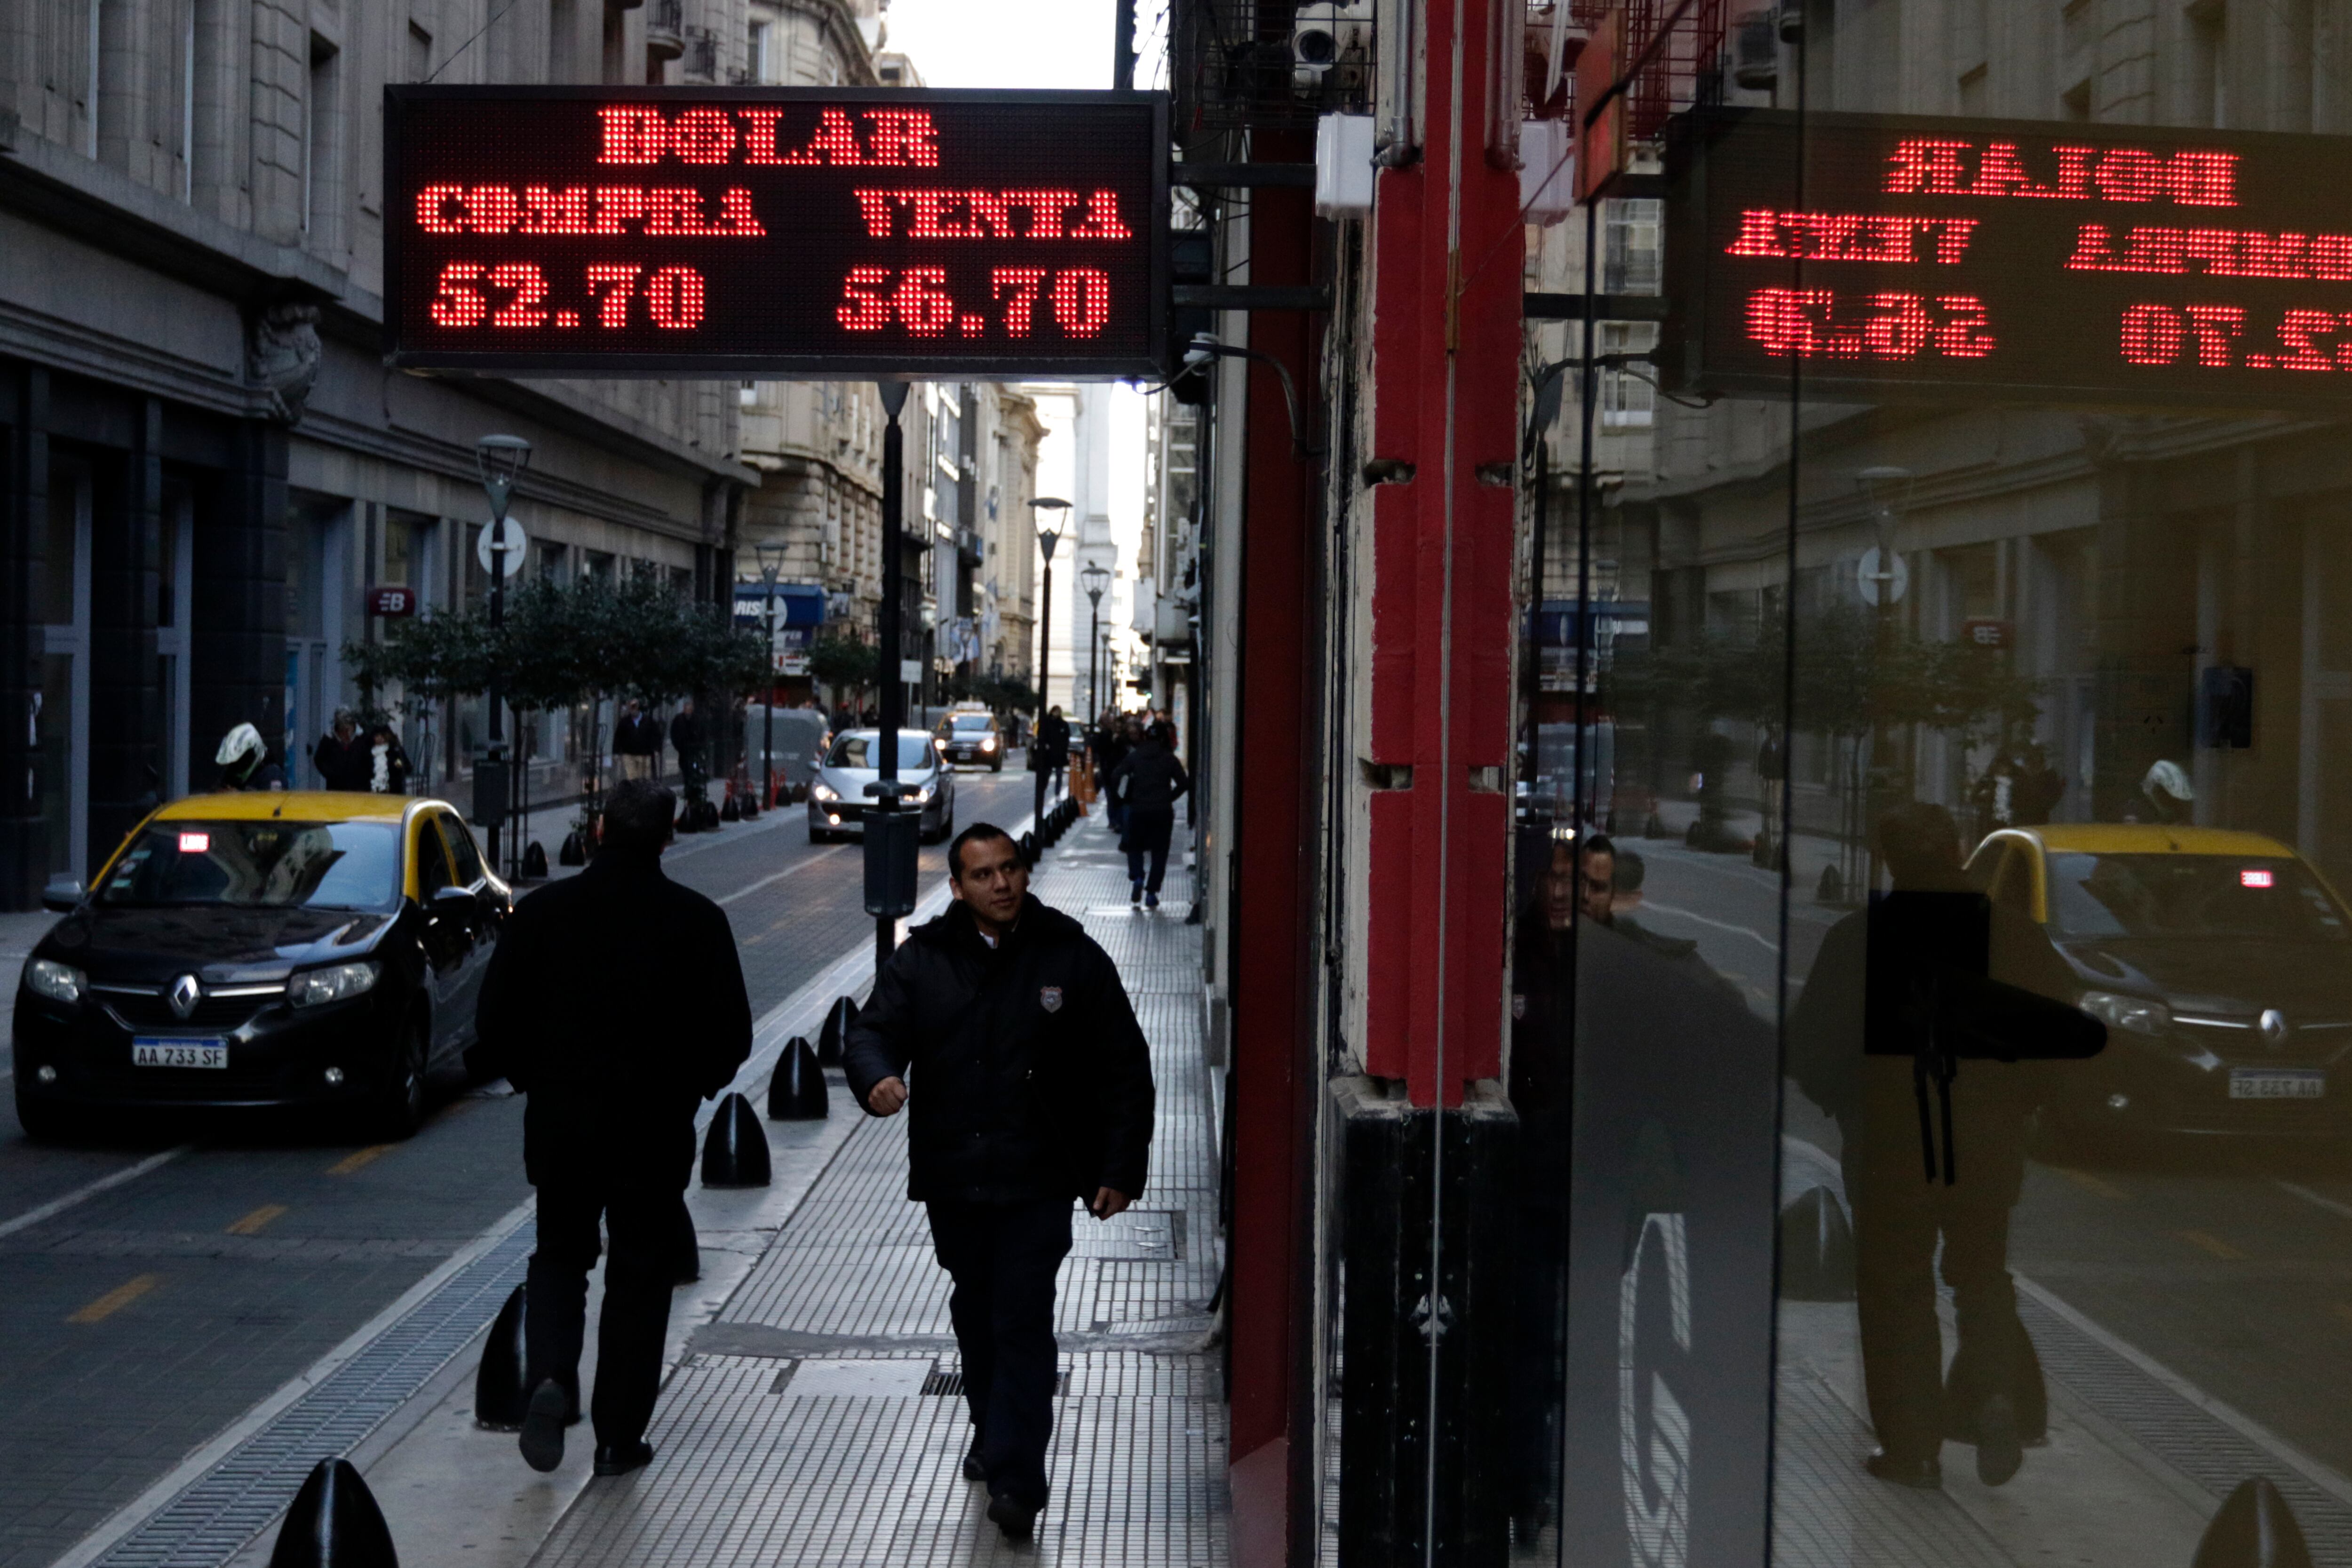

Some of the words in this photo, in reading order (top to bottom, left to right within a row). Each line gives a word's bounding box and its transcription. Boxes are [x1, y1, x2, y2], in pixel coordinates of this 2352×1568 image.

[596, 105, 939, 167] DOLAR
[416, 182, 767, 237] COMPRA
[852, 186, 1132, 240] VENTA
[430, 260, 706, 329] 52.70
[835, 263, 1111, 338] 56.70
[138, 1048, 159, 1064] AA
[165, 1049, 196, 1065] 733
[202, 1050, 223, 1066] SF
